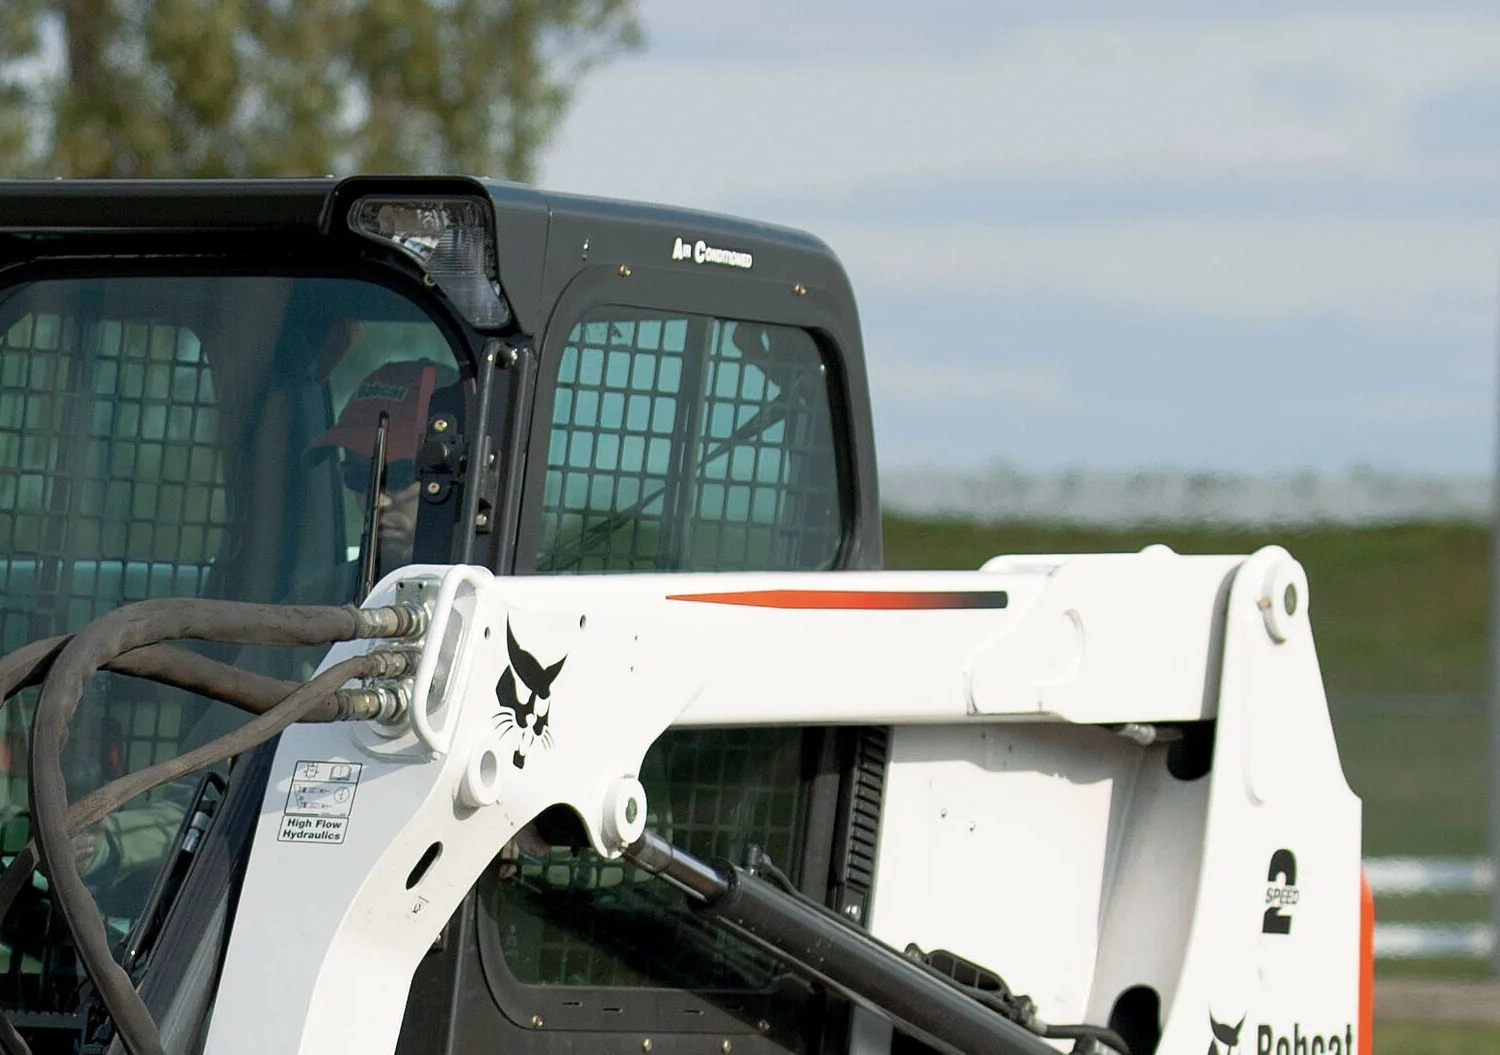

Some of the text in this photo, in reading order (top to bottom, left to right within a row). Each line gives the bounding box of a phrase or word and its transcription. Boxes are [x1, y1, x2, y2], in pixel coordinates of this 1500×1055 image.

[287, 818, 342, 829] High Flow
[282, 829, 341, 840] Hydraulics
[1265, 887, 1300, 906] SPEED
